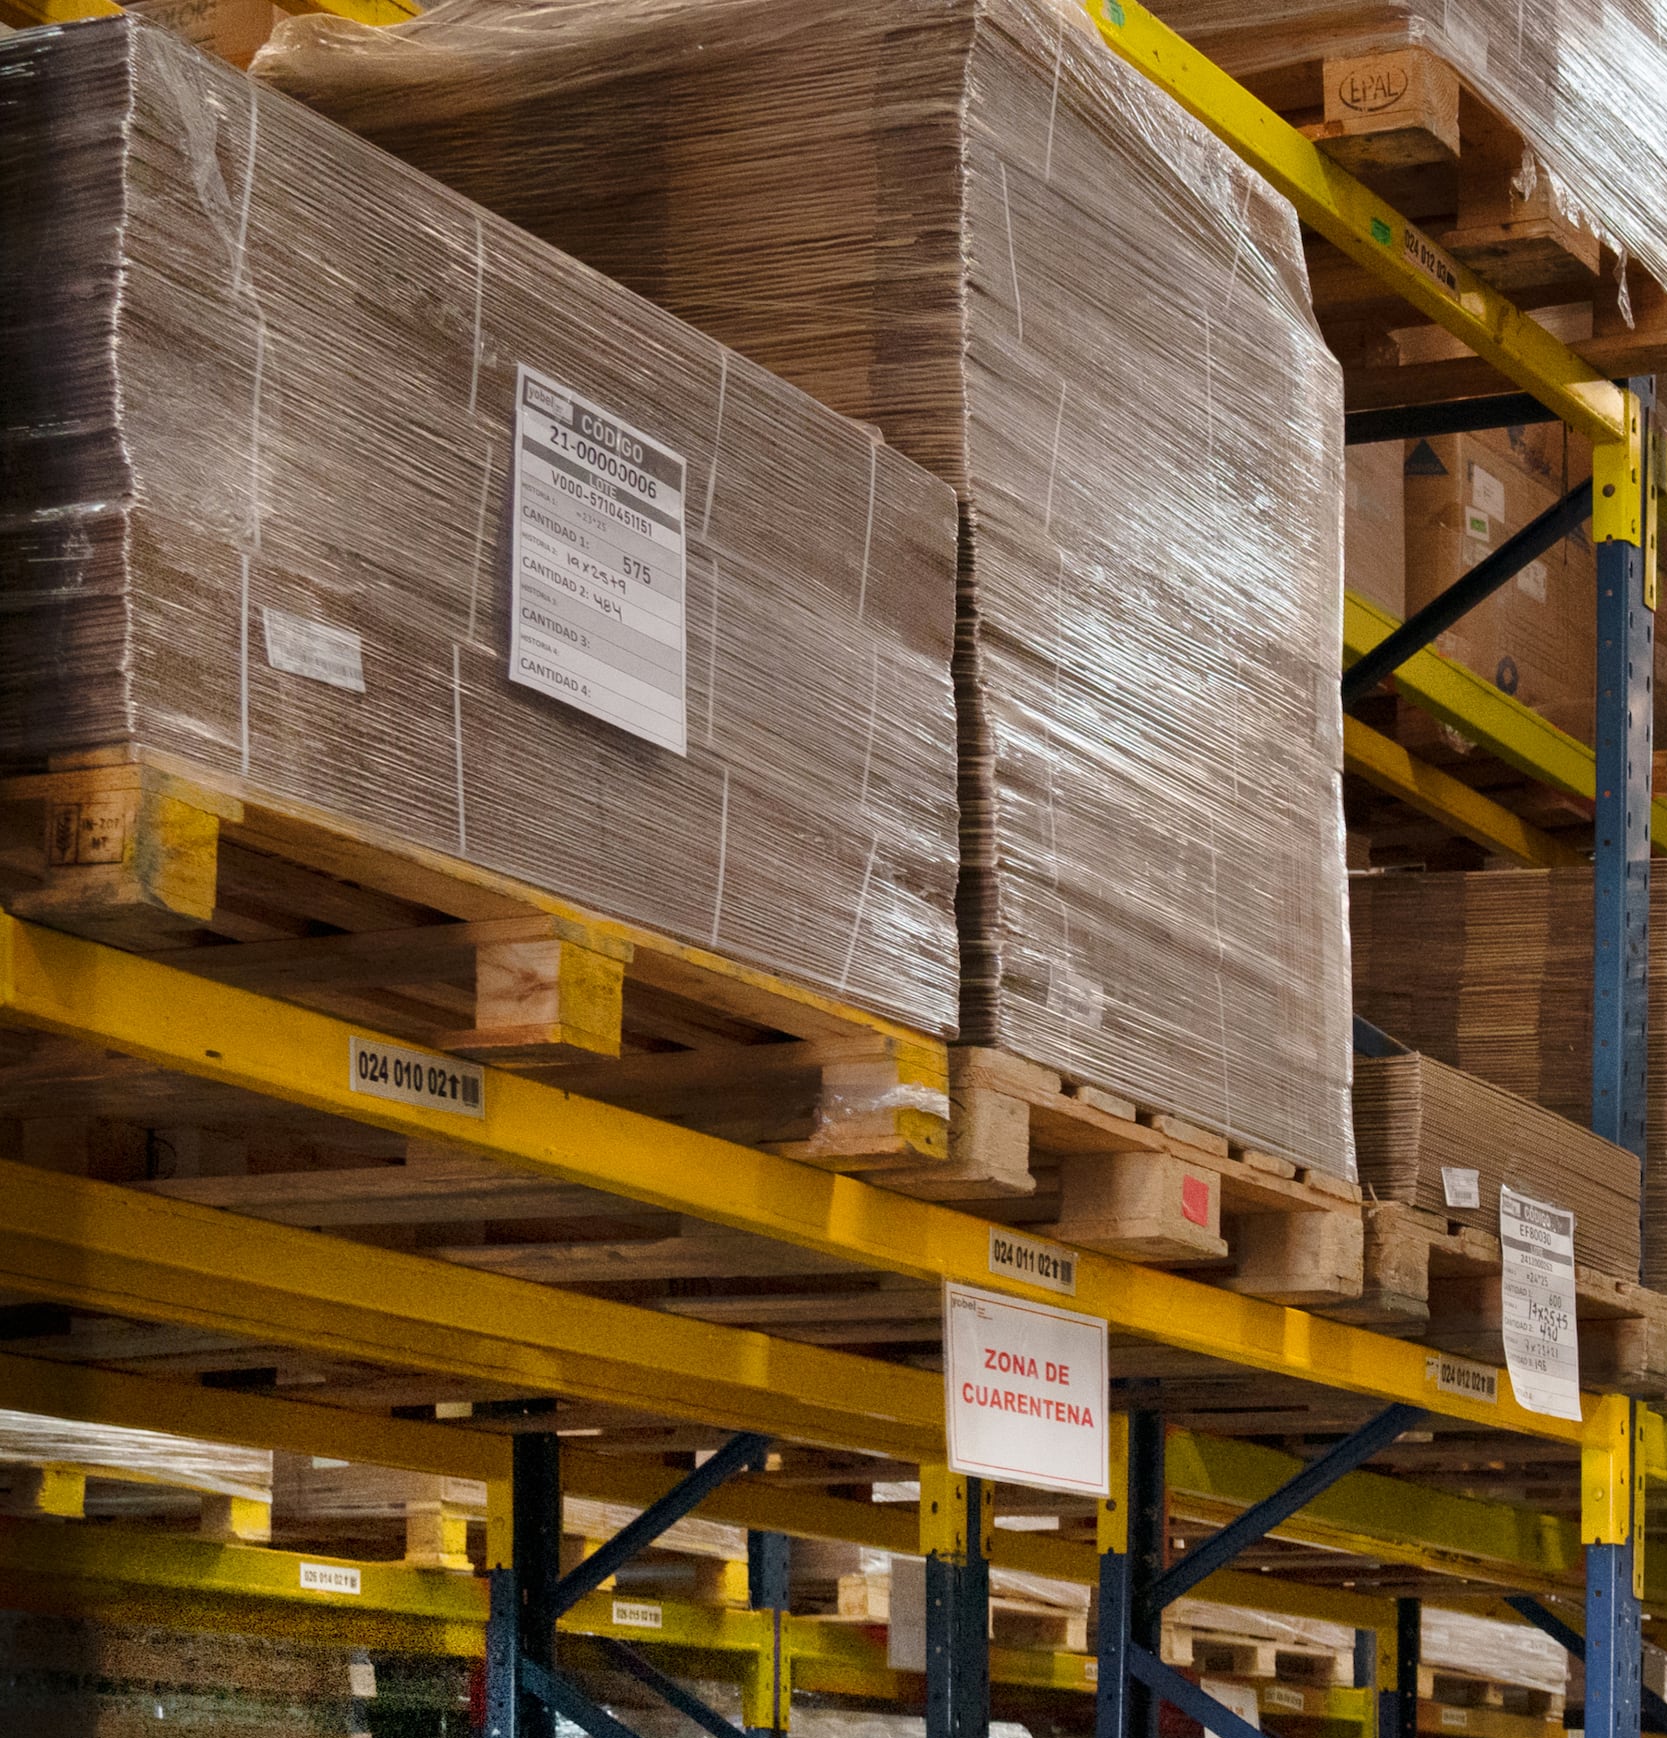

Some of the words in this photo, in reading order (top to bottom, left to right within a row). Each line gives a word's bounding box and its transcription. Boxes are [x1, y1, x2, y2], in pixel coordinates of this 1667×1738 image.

[1350, 72, 1398, 103] EPAL
[529, 386, 554, 406] yobel
[581, 414, 643, 463] CÓDIGO
[588, 474, 618, 498] LOTE
[523, 505, 577, 543] CANTIDAD
[523, 557, 577, 592] CANTIDAD
[623, 556, 652, 584] 575
[522, 608, 578, 642] CANTIDAD
[521, 658, 578, 692] CANTIDAD
[359, 1051, 388, 1084] 024
[394, 1059, 423, 1092] 010
[428, 1067, 447, 1097] 02
[993, 1239, 1013, 1266] 024
[1016, 1246, 1035, 1273] 011
[1038, 1254, 1051, 1278] 02
[951, 1299, 976, 1313] yobel
[984, 1348, 1039, 1380] ZONA
[1045, 1362, 1070, 1386] DE
[962, 1382, 1095, 1428] CUARENTENA
